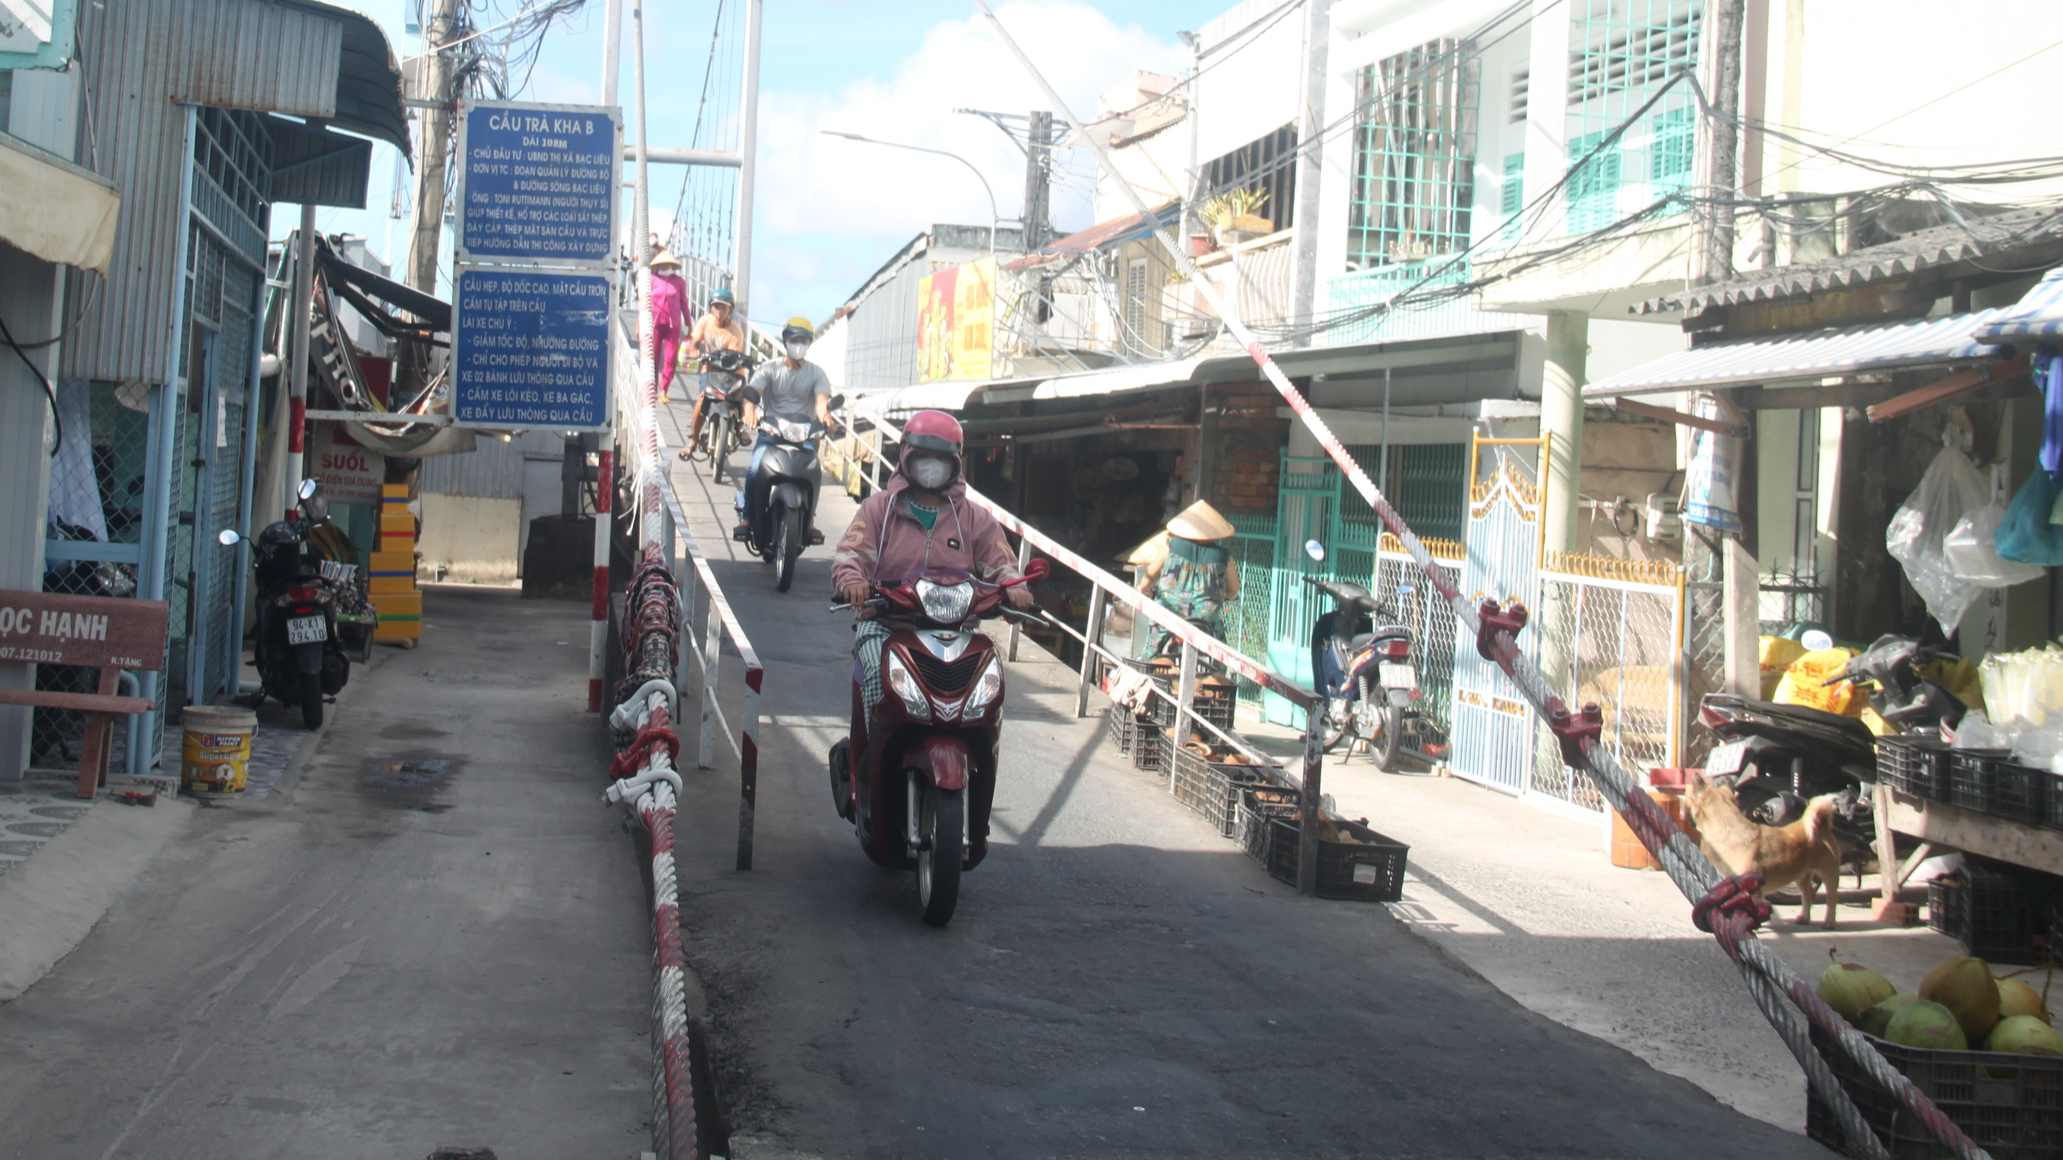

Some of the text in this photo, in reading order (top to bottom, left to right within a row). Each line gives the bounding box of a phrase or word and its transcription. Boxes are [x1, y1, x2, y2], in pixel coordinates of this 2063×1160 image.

[489, 110, 593, 135] CẦU TRÀ KHA B
[542, 138, 567, 149] 108M
[474, 146, 491, 159] CHỦ
[493, 147, 510, 160] ĐẦU
[512, 150, 522, 160] TƯ
[528, 153, 548, 162] UBND
[550, 153, 561, 164] THỊ
[575, 154, 591, 166] BẠC
[594, 154, 610, 165] LIÊU
[473, 164, 489, 173] ĐƠN
[492, 167, 498, 176] VỊ
[500, 166, 508, 175] TC
[514, 167, 536, 178] ĐOẠN
[537, 165, 559, 177] QUẢN
[600, 169, 609, 181] BỘ
[573, 184, 588, 195] BẠC
[590, 183, 605, 194] LIÊU
[472, 191, 489, 204] ÔNG
[495, 195, 510, 204] TONI
[512, 196, 550, 206] RUTTIMANN
[544, 210, 559, 221] CÁC
[561, 212, 576, 224] LOẠI
[505, 223, 522, 235] THÉP
[532, 240, 541, 250] THI
[544, 239, 566, 251] CÔNG
[465, 276, 483, 292] CẦU
[502, 282, 512, 296] ĐỘ
[532, 284, 551, 295] CAO,
[588, 285, 606, 296] TRƠN
[484, 301, 493, 313] TỤ
[509, 299, 527, 311] TRÊN
[463, 314, 474, 327] LÁI
[477, 318, 486, 328] XE
[488, 316, 505, 328] CHÚ
[473, 332, 495, 346] GIẢM
[498, 334, 513, 347] TỐC
[570, 337, 599, 350] ĐƯỜNG
[473, 351, 488, 365] CHỈ
[491, 354, 508, 366] CHO
[510, 354, 530, 366] PHÉP
[573, 357, 584, 370] BỘ
[462, 372, 472, 382] XE
[475, 373, 483, 382] 02
[486, 371, 508, 382] BÁNH
[510, 372, 525, 383] LƯU
[556, 375, 573, 385] QUA
[576, 372, 594, 386] CẦU
[491, 391, 502, 400] XE
[505, 389, 518, 401] LÔI
[543, 392, 554, 402] XE
[557, 393, 568, 403] BA
[570, 391, 593, 404] GÁC,
[461, 408, 472, 418] XE
[498, 408, 514, 420] LƯU
[517, 407, 547, 421] THÔNG
[550, 410, 570, 421] QUA
[573, 406, 592, 421] CẦU
[344, 476, 355, 486] GIA
[40, 610, 108, 643] HẠNH
[290, 629, 324, 643] 294.10
[0, 647, 62, 663] 07.121012
